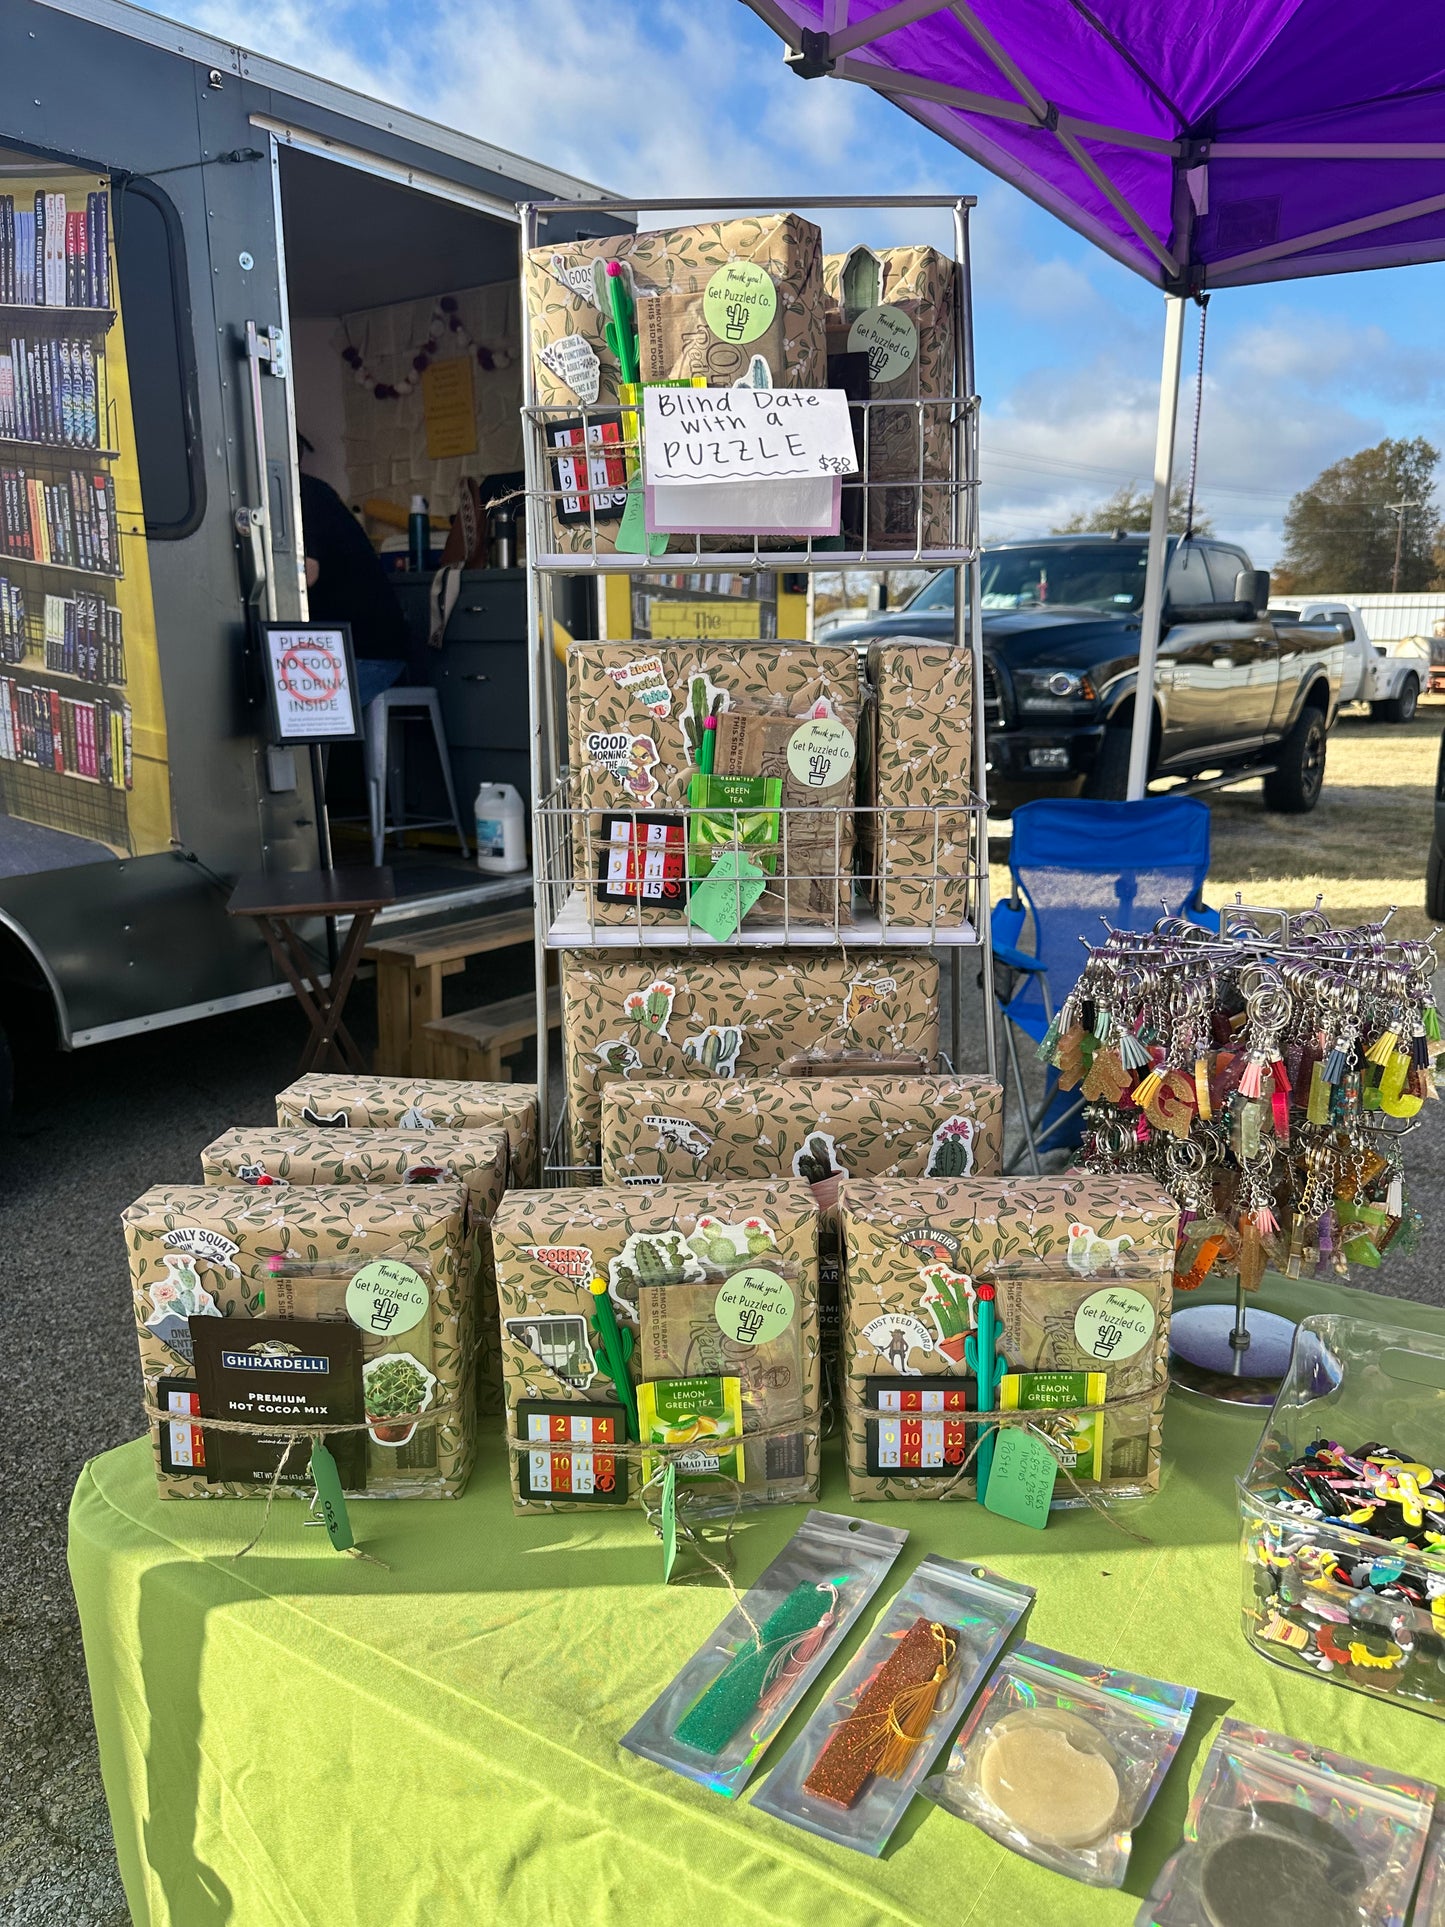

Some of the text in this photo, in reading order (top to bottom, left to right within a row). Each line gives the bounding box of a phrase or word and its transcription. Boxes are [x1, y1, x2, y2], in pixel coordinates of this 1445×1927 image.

[726, 269, 762, 287] Thank you!
[709, 287, 772, 306] Get Puzzled Co.
[857, 324, 911, 360] Get Puzzled Co.
[651, 350, 659, 377] DOWN
[658, 391, 820, 416] Blind Date
[766, 412, 783, 427] a
[560, 429, 598, 447] 1 3
[664, 434, 806, 468] PUZZLE
[565, 472, 606, 489] 9 11
[77, 600, 87, 628] Silva
[88, 601, 98, 631] Silva
[694, 612, 722, 630] The
[280, 637, 334, 648] PLEASE
[276, 658, 342, 670] NO FOOD
[278, 679, 348, 691] OR DRINK
[289, 700, 338, 712] INSIDE
[811, 726, 845, 742] Thank you!
[793, 740, 851, 758] Get Puzzled Co.
[730, 796, 744, 804] TEA
[617, 824, 662, 839] 1 3
[614, 861, 680, 877] 9 11 12
[647, 883, 660, 895] 15
[168, 1230, 235, 1254] ONLY SQUAT
[900, 1230, 958, 1250] N'T IT WEIRD
[538, 1249, 590, 1265] SORRY,
[378, 1264, 418, 1285] Thank you!
[356, 1279, 424, 1305] Get Puzzled Co.
[744, 1276, 783, 1296] Thank you!
[1007, 1282, 1015, 1301] THIS
[277, 1280, 286, 1319] THIS SIDE
[285, 1280, 294, 1310] REMOVE
[1106, 1294, 1145, 1313] Thank you!
[722, 1292, 788, 1316] Get Puzzled Co.
[652, 1310, 660, 1328] SIDE
[869, 1316, 912, 1333] JUST YEED
[1083, 1305, 1146, 1334] Get Puzzled Co.
[1005, 1326, 1013, 1352] DOWN
[227, 1356, 324, 1370] GHIRARDELLI
[176, 1396, 183, 1408] 1
[249, 1393, 306, 1403] PREMIUM
[673, 1390, 705, 1400] LEMON
[699, 1399, 714, 1407] TEA
[886, 1394, 959, 1407] 1 2 3 4
[229, 1402, 328, 1414] HOT COCOA MIX
[535, 1418, 608, 1433] 1 2 3 4
[176, 1433, 185, 1443] 9
[884, 1432, 962, 1445] 9 10 11 12
[175, 1451, 190, 1462] 13
[535, 1457, 612, 1472] 9 10 11 12
[882, 1451, 941, 1464] 13 14 15
[997, 1441, 1016, 1478] Pastel
[1061, 1455, 1076, 1463] TEA
[533, 1475, 592, 1490] 13 14 15
